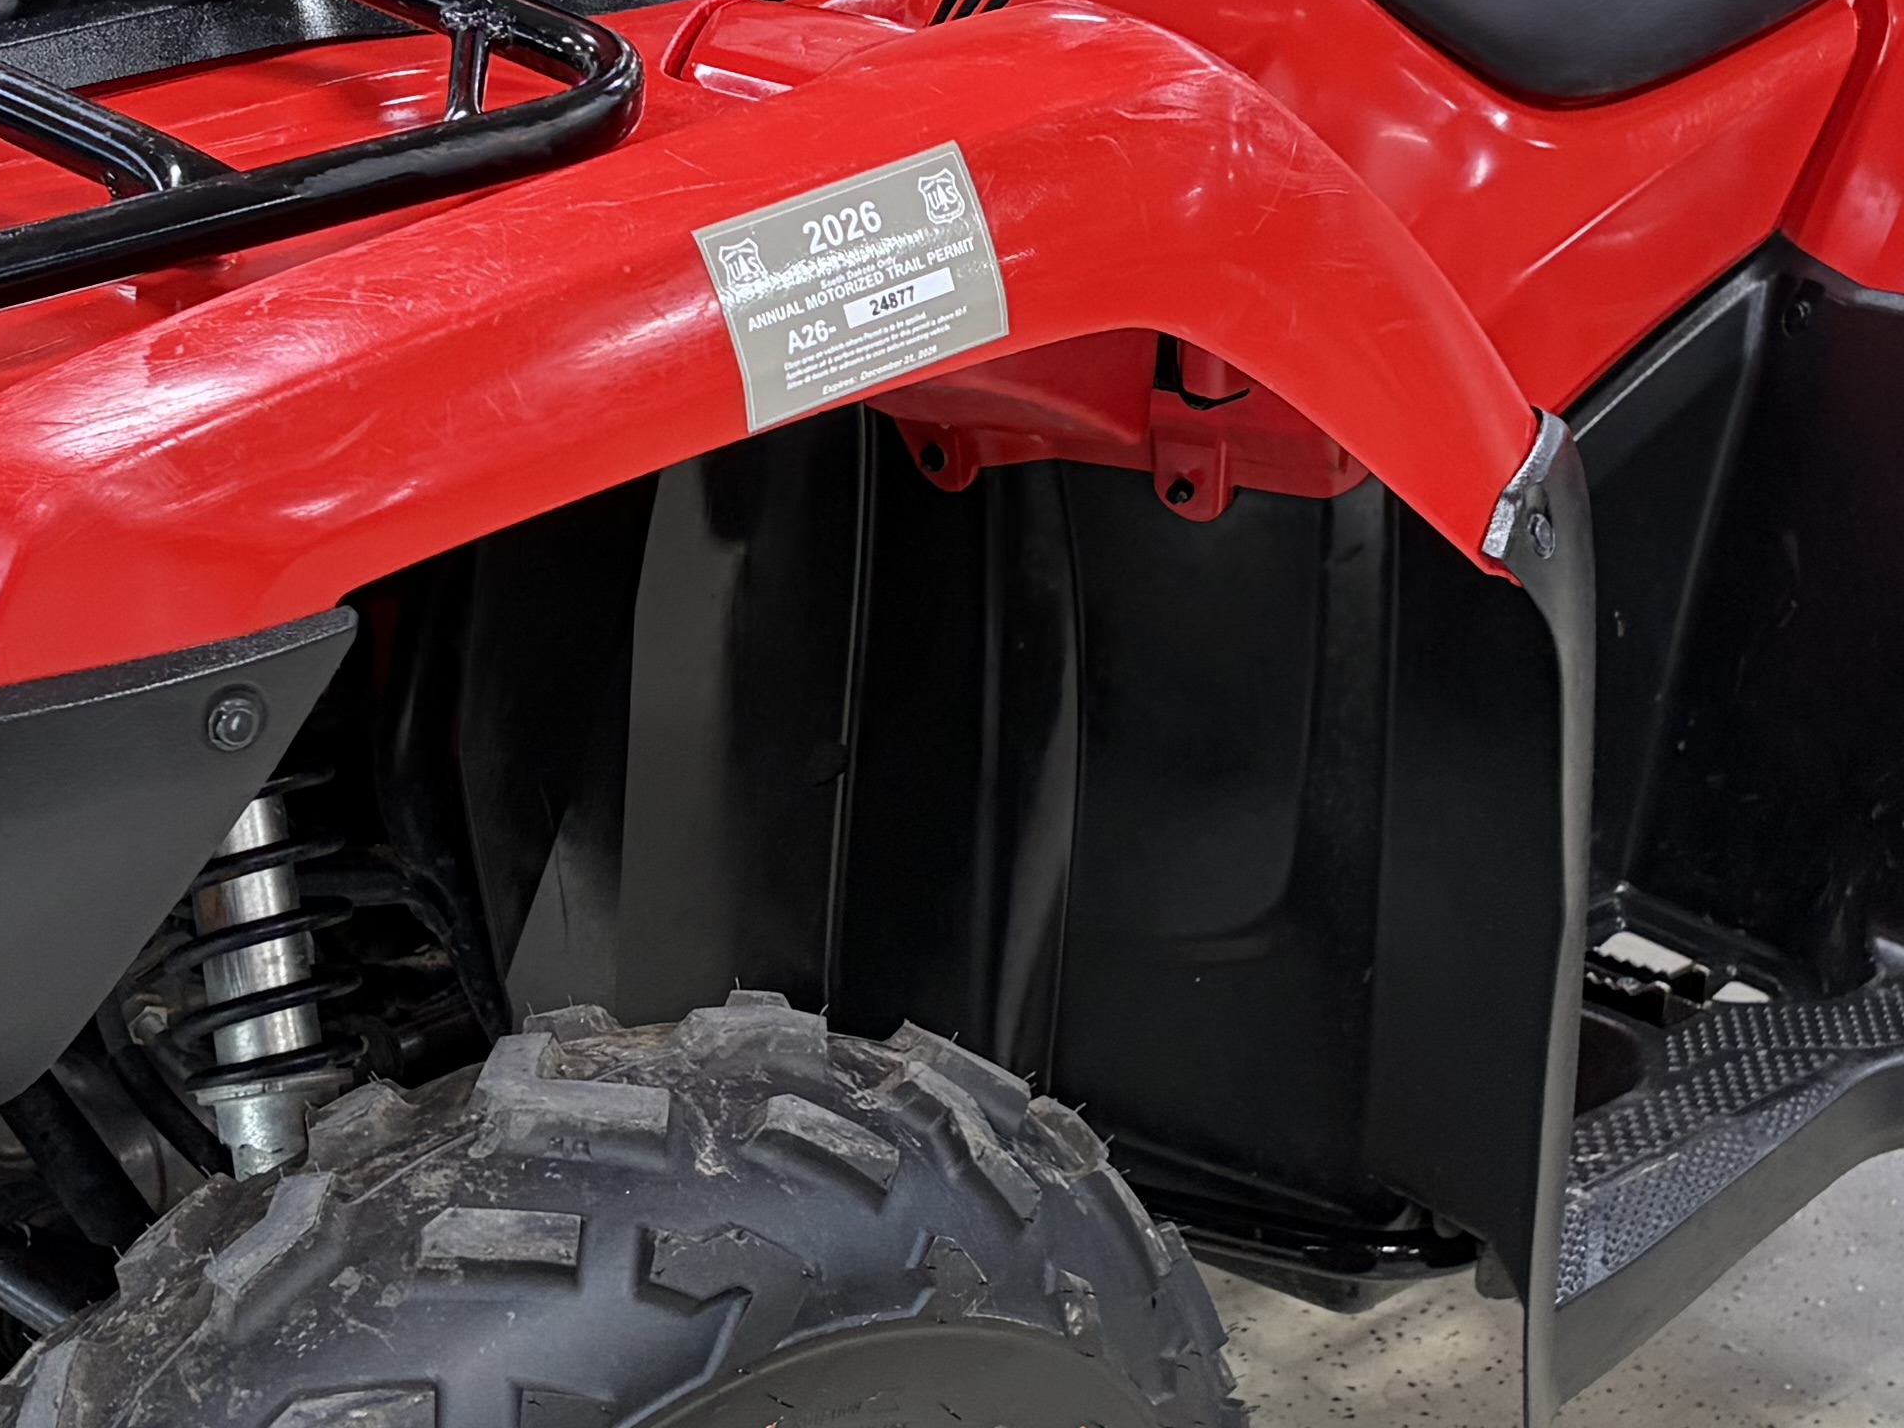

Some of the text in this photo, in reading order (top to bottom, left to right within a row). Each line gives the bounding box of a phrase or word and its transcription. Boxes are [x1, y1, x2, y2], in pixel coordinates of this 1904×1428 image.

[802, 201, 881, 253] 2026
[748, 235, 974, 331] ANNUAL MOTORIZED TRAIL PERMIT
[787, 285, 914, 354] A26- 24877
